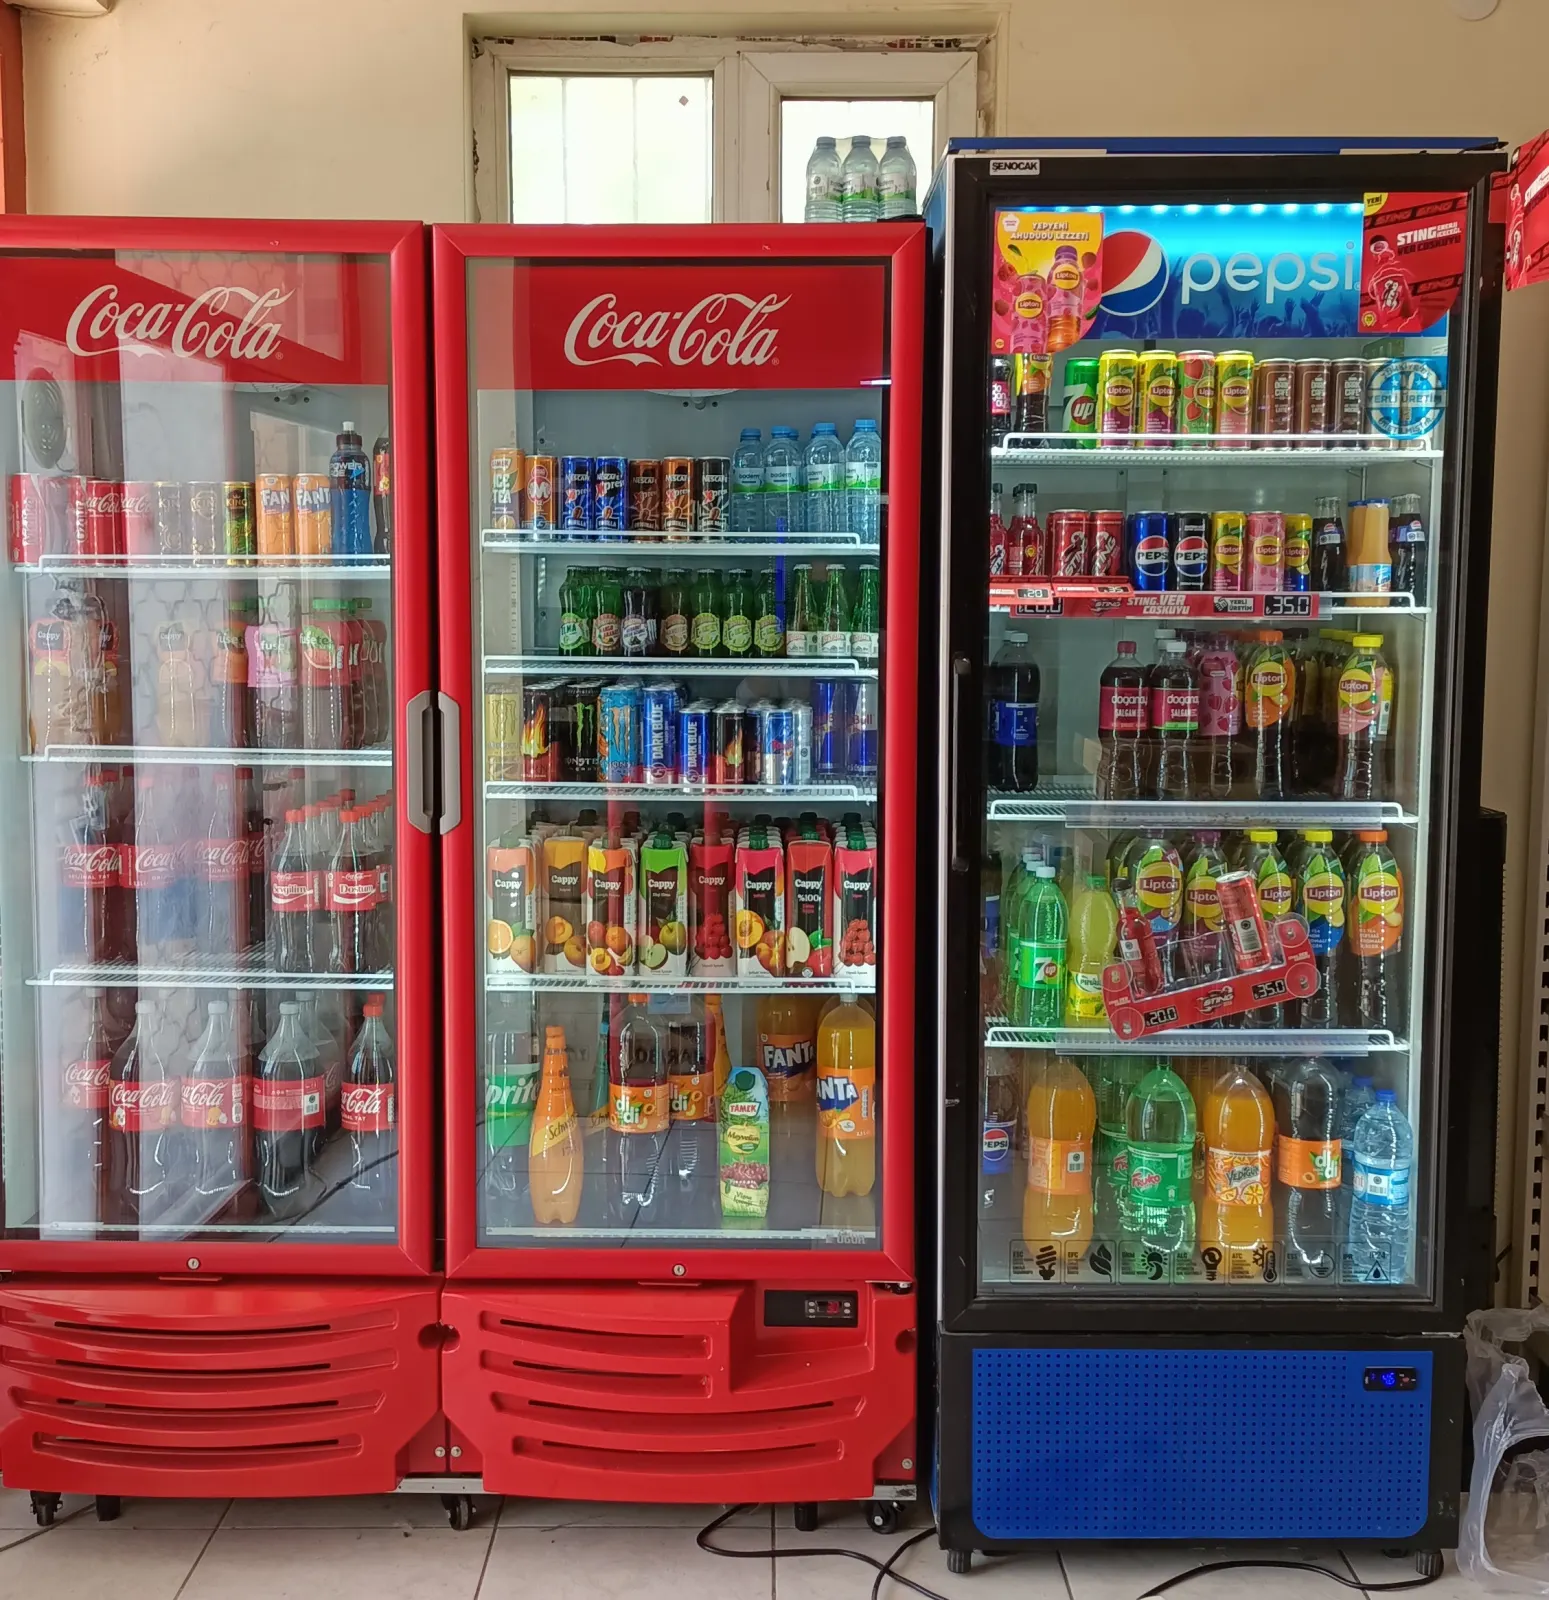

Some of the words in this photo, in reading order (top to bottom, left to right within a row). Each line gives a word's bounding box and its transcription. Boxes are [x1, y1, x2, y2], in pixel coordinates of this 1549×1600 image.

[992, 161, 1037, 172] ŞENOCAK
[1010, 232, 1054, 241] AHUDUDU
[1397, 226, 1437, 246] STING
[1057, 272, 1077, 280] Lipton
[1181, 241, 1355, 305] pepsi
[1019, 301, 1040, 309] Lipton
[65, 284, 296, 360] Coca-Cola
[563, 293, 793, 367] Coca-Cola
[1108, 387, 1131, 395] Lipton
[493, 474, 511, 488] ICE
[492, 489, 512, 504] TEA
[1254, 674, 1282, 685] Lipton
[1341, 680, 1369, 692] Lipton
[652, 703, 664, 732] BLUE
[688, 721, 698, 745] BLUE
[652, 732, 664, 760] DARK
[688, 745, 698, 768] DARK
[551, 875, 578, 887] Cappy
[594, 879, 621, 891] Cappy
[648, 879, 676, 890] Cappy
[698, 876, 726, 886] Cappy
[745, 881, 773, 891] Cappy
[795, 879, 823, 890] Cappy
[843, 881, 871, 891] Cappy
[1143, 879, 1178, 891] Lipton
[1309, 888, 1341, 900] Lipton
[1363, 888, 1397, 900] Lipton
[111, 1081, 176, 1108] Coca-Cola
[730, 1104, 757, 1113] TAMEK
